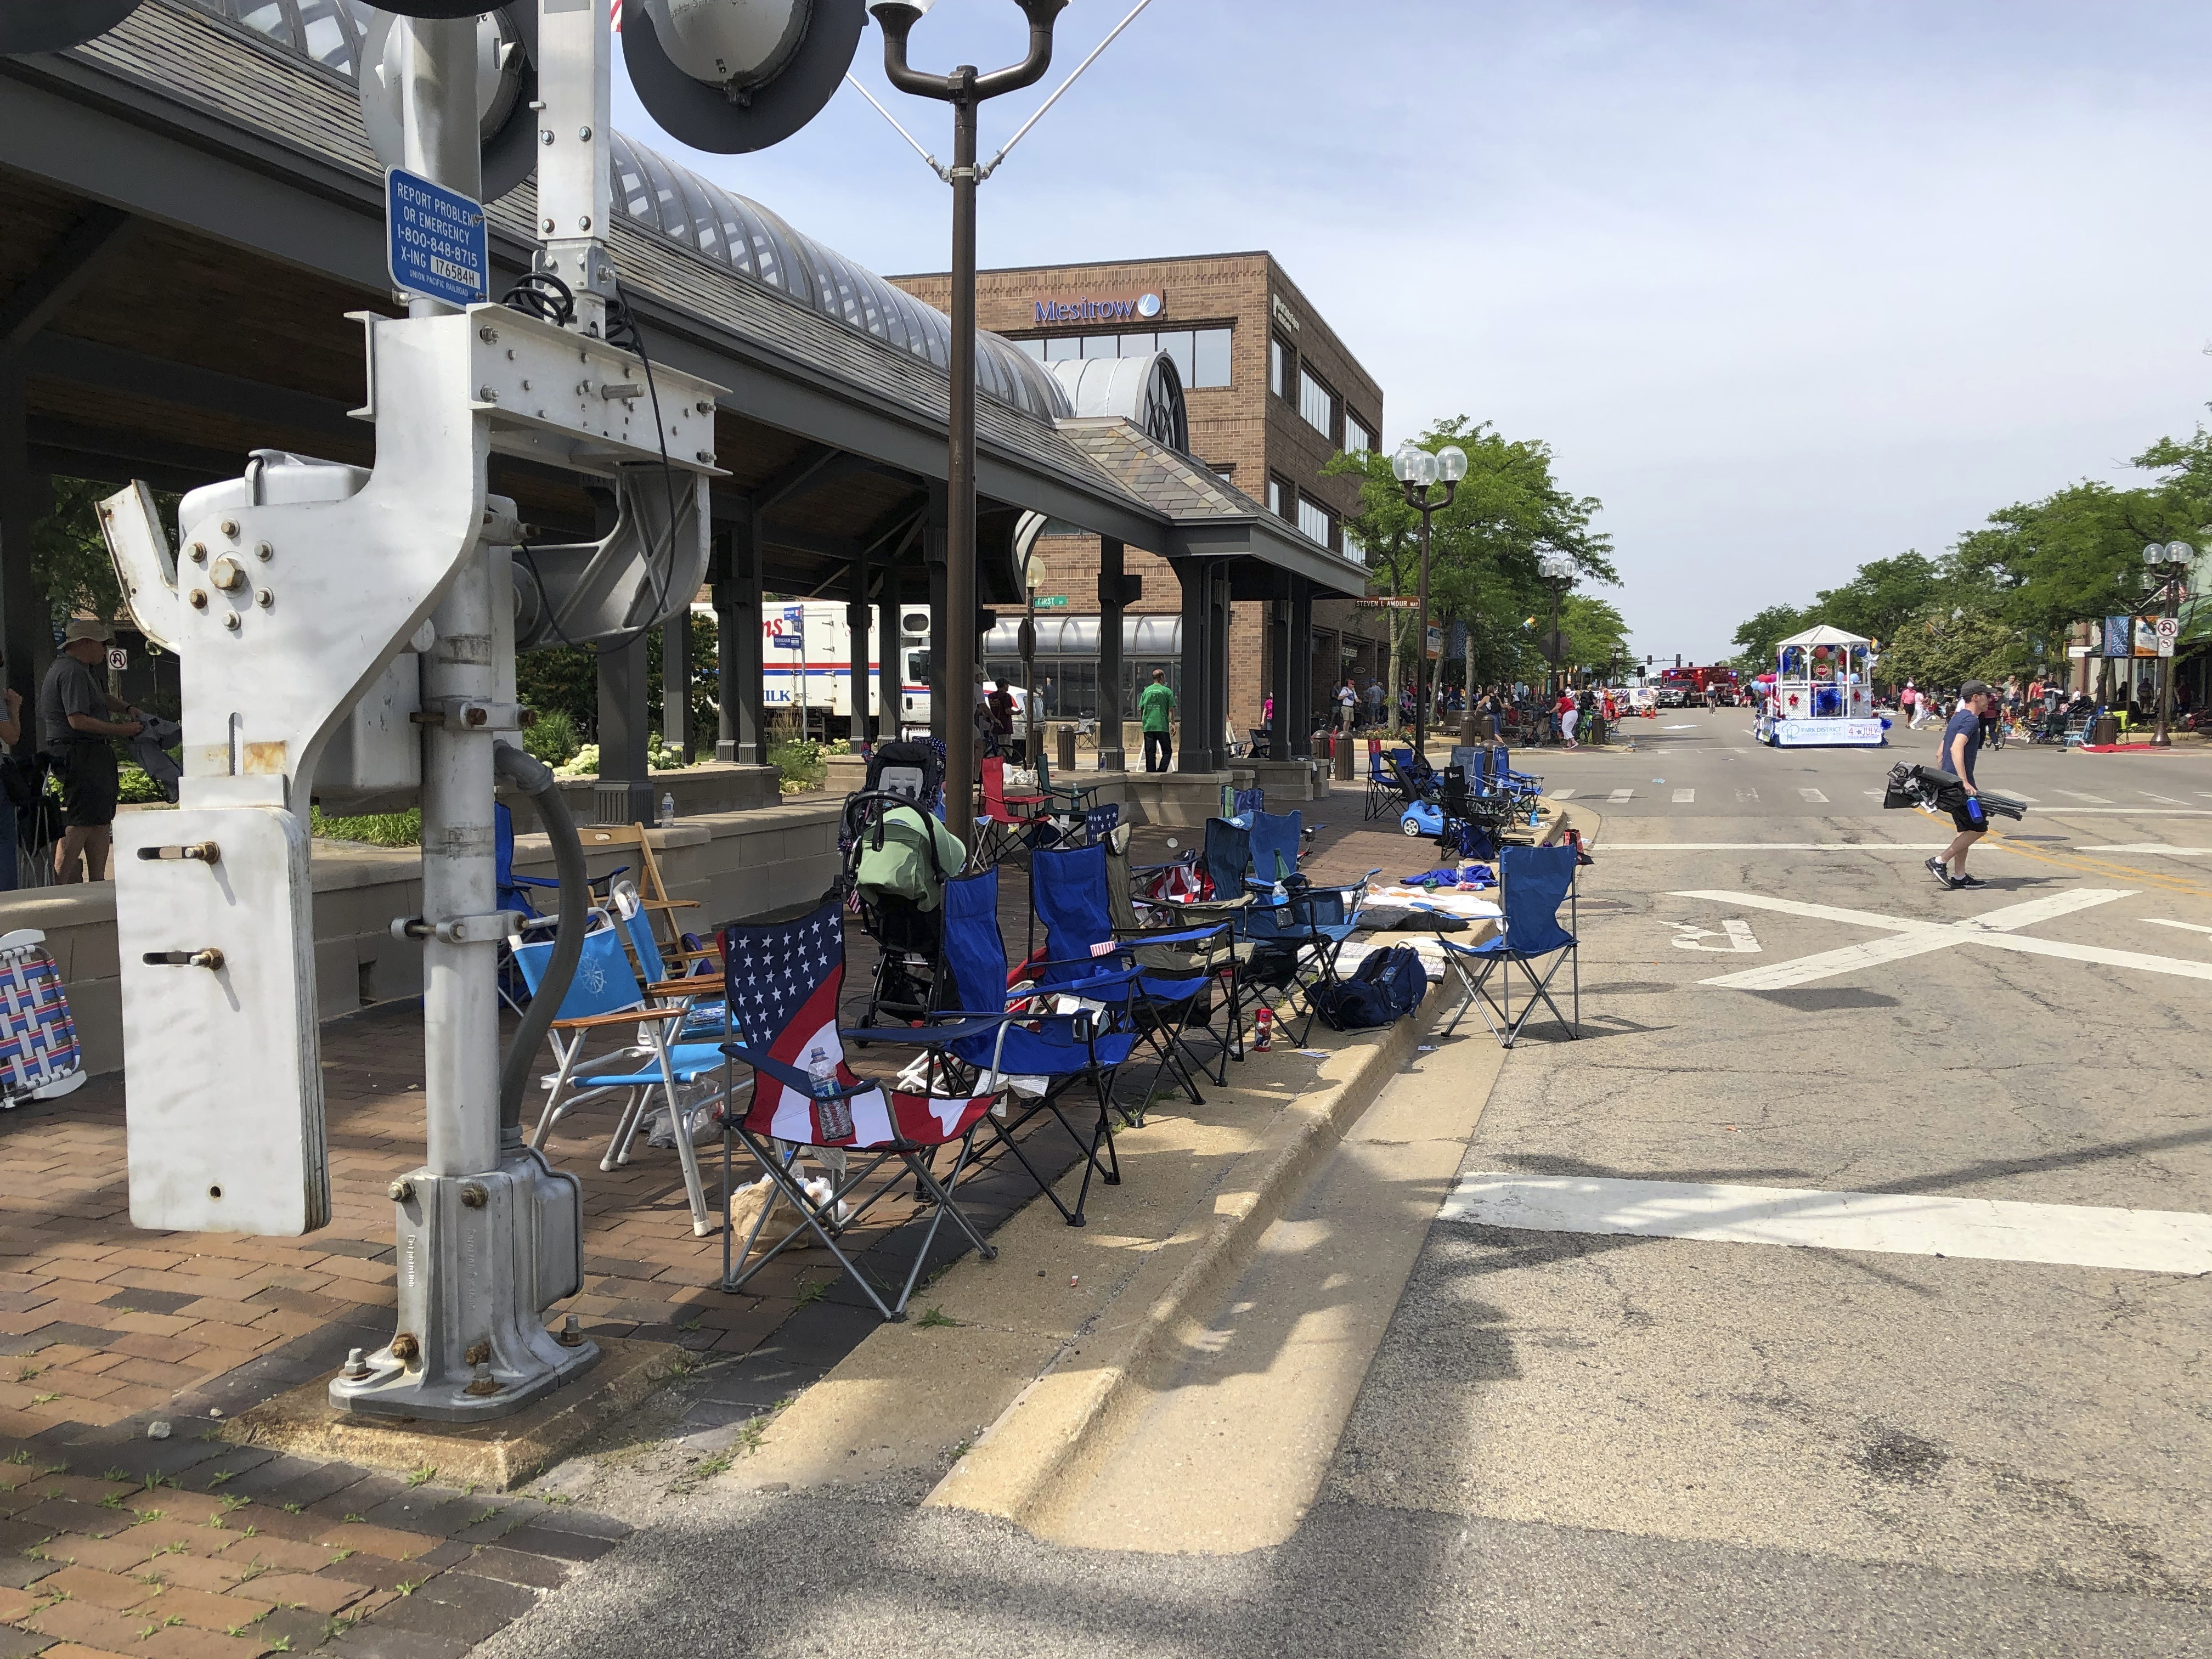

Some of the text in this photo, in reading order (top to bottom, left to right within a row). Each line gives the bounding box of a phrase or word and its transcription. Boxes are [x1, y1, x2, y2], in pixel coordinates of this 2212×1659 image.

[397, 182, 475, 228] REPORT PROBLEM
[403, 206, 470, 245] OR EMERGENCY
[397, 224, 477, 267] 1-800-848-8715
[401, 245, 475, 286] X-ING 176584H
[409, 269, 469, 297] UNION PACIFIC RAILROAD
[1034, 296, 1136, 321] Mesirow
[763, 690, 791, 702] ILK
[1848, 727, 1879, 736] 4 JULY
